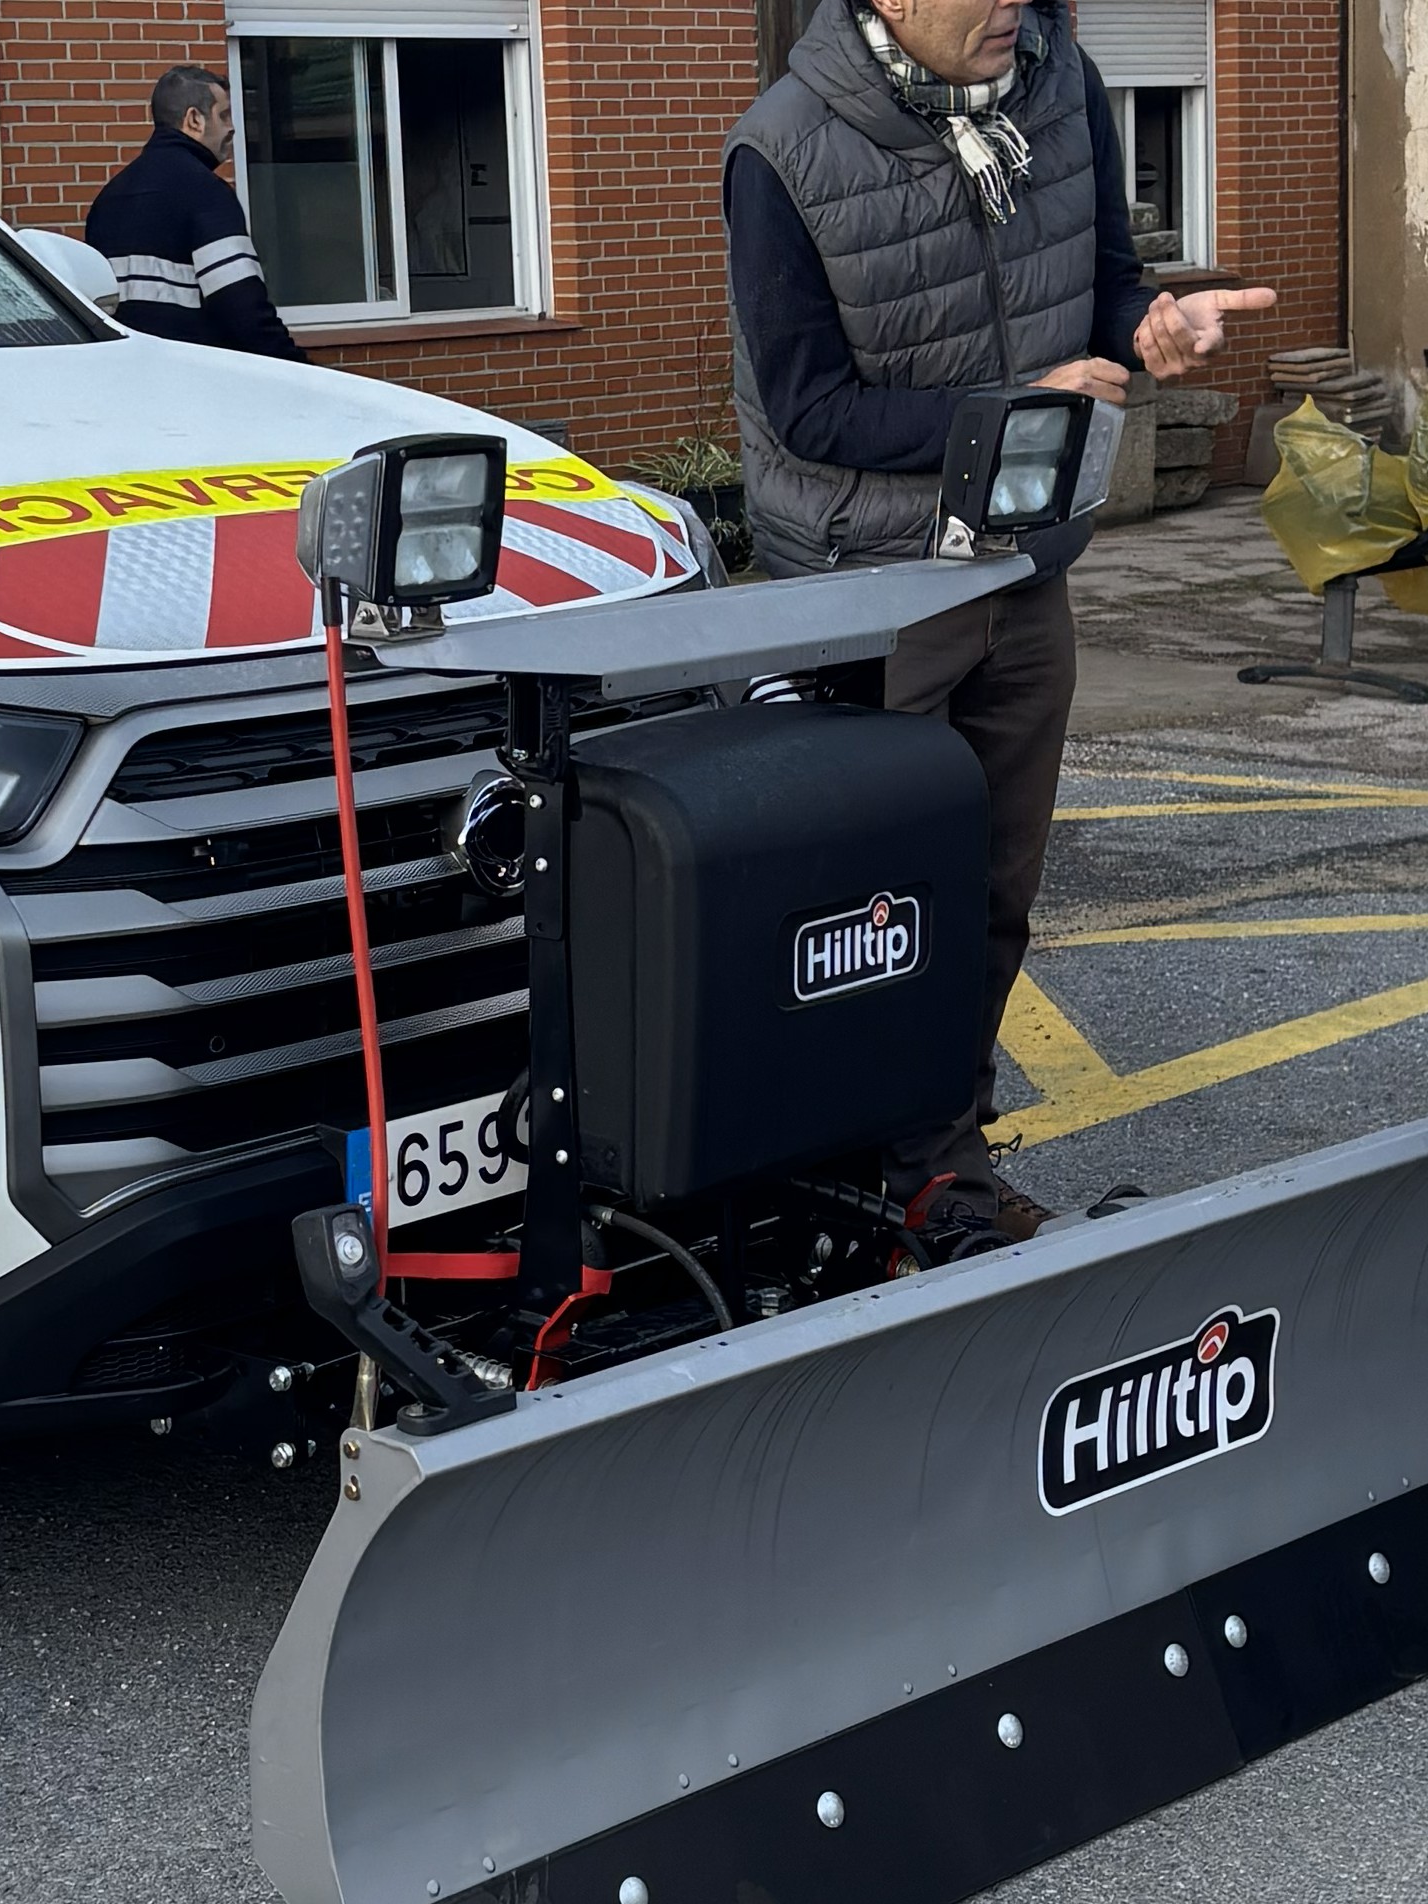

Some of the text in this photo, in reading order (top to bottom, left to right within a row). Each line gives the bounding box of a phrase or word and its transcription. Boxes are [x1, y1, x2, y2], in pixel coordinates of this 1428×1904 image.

[807, 901, 909, 984] Hilltip
[397, 1108, 529, 1207] 659
[1063, 1322, 1256, 1485] Hilltip
